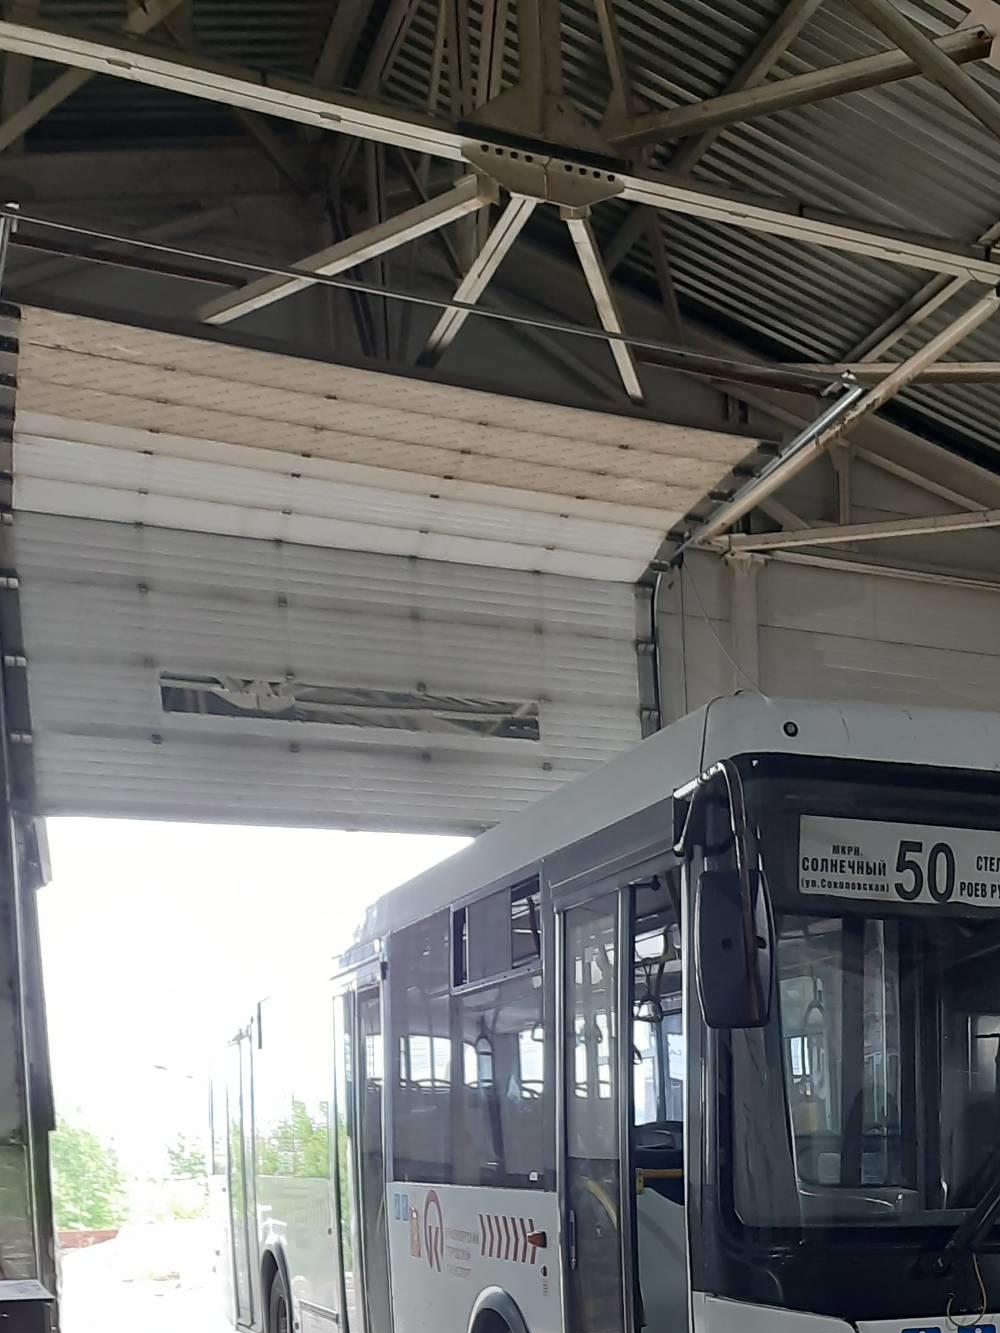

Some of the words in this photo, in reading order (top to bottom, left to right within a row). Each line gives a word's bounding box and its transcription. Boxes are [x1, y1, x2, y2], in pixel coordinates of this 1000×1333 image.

[801, 857, 886, 877] СОЛНЕЧНЫЙ
[895, 840, 956, 902] 50
[959, 881, 988, 898] РОЕВ
